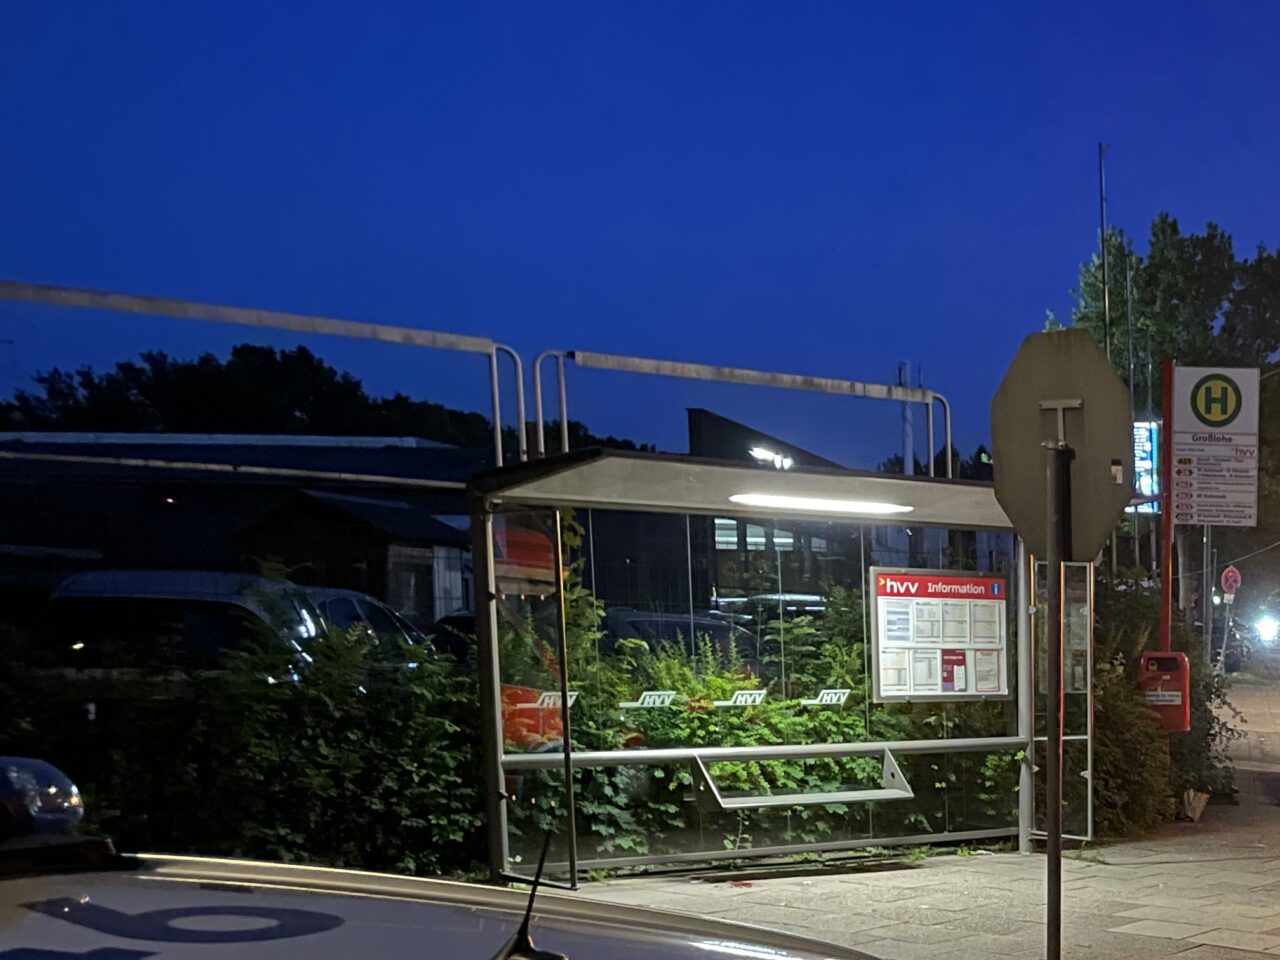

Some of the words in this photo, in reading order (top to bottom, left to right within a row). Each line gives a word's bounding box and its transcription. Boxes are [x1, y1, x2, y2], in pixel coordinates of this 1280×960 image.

[1204, 386, 1228, 415] H
[1191, 434, 1233, 443] Großlohe
[886, 578, 919, 594] hvv
[928, 582, 985, 595] Information
[644, 693, 674, 706] HVV
[736, 692, 766, 705] HVV
[822, 692, 849, 705] HVV
